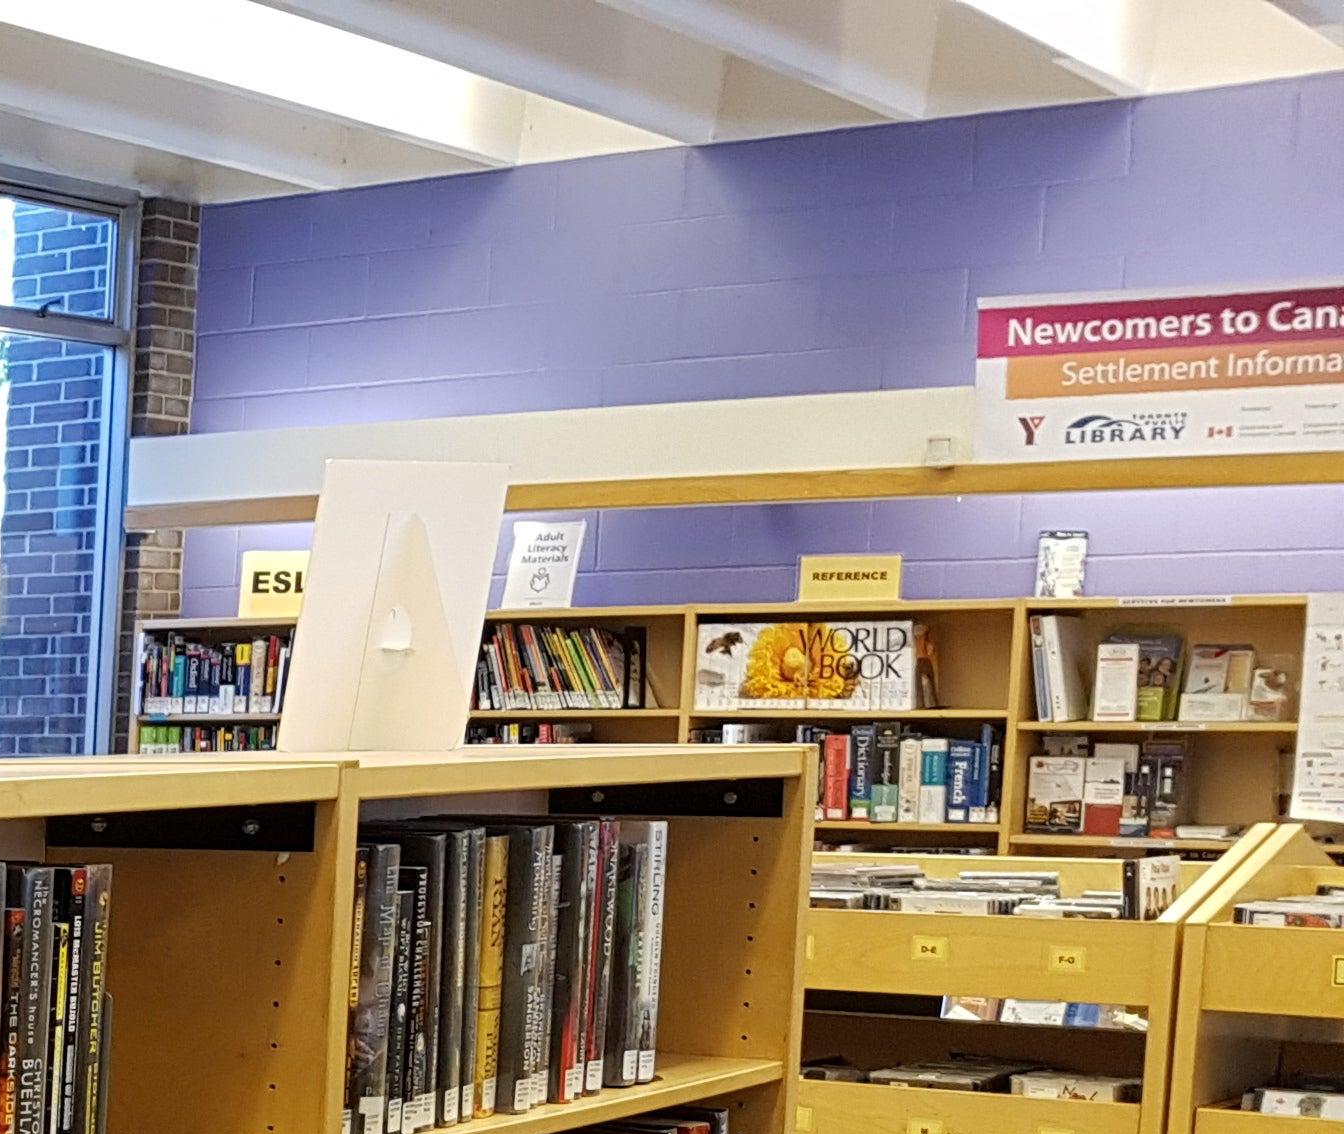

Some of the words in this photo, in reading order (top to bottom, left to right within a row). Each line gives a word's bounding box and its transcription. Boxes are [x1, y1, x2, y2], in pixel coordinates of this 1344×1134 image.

[1007, 312, 1212, 346] Newcomers
[1220, 311, 1260, 335] to
[1268, 299, 1344, 332] Can
[1061, 357, 1219, 387] Settlement
[1064, 426, 1185, 444] LIBRARY
[527, 543, 568, 555] Literacy
[536, 531, 564, 542] Adult
[521, 554, 569, 564] Materials
[251, 570, 305, 594] ESL
[812, 570, 889, 582] REFERENCE
[799, 626, 907, 655] WORLD
[818, 652, 900, 681] BOOK
[651, 830, 662, 916] STIRLING
[29, 880, 44, 1001] NECROMANCER'S
